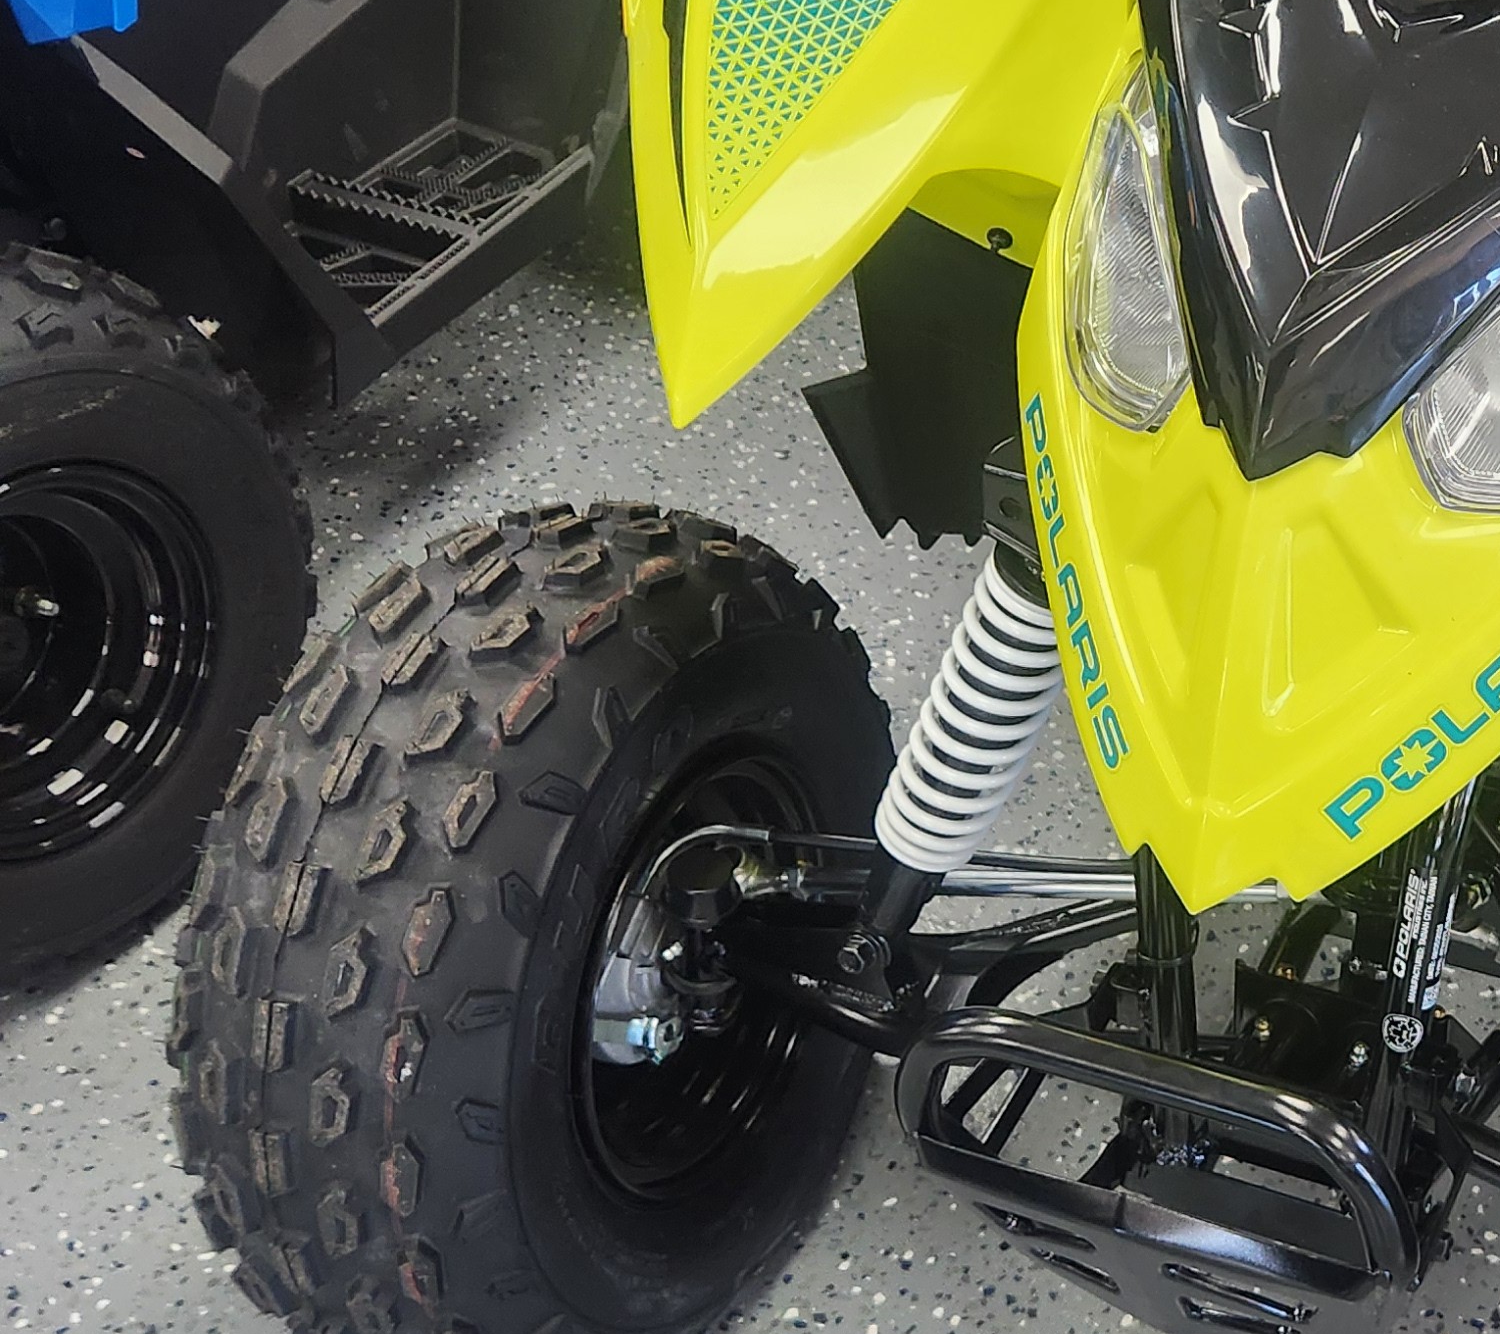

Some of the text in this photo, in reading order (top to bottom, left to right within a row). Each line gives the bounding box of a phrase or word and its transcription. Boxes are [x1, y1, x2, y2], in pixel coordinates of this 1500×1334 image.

[1024, 392, 1132, 770] POLARIS
[1396, 874, 1419, 958] POLARIS
[1423, 904, 1434, 921] CITY,
